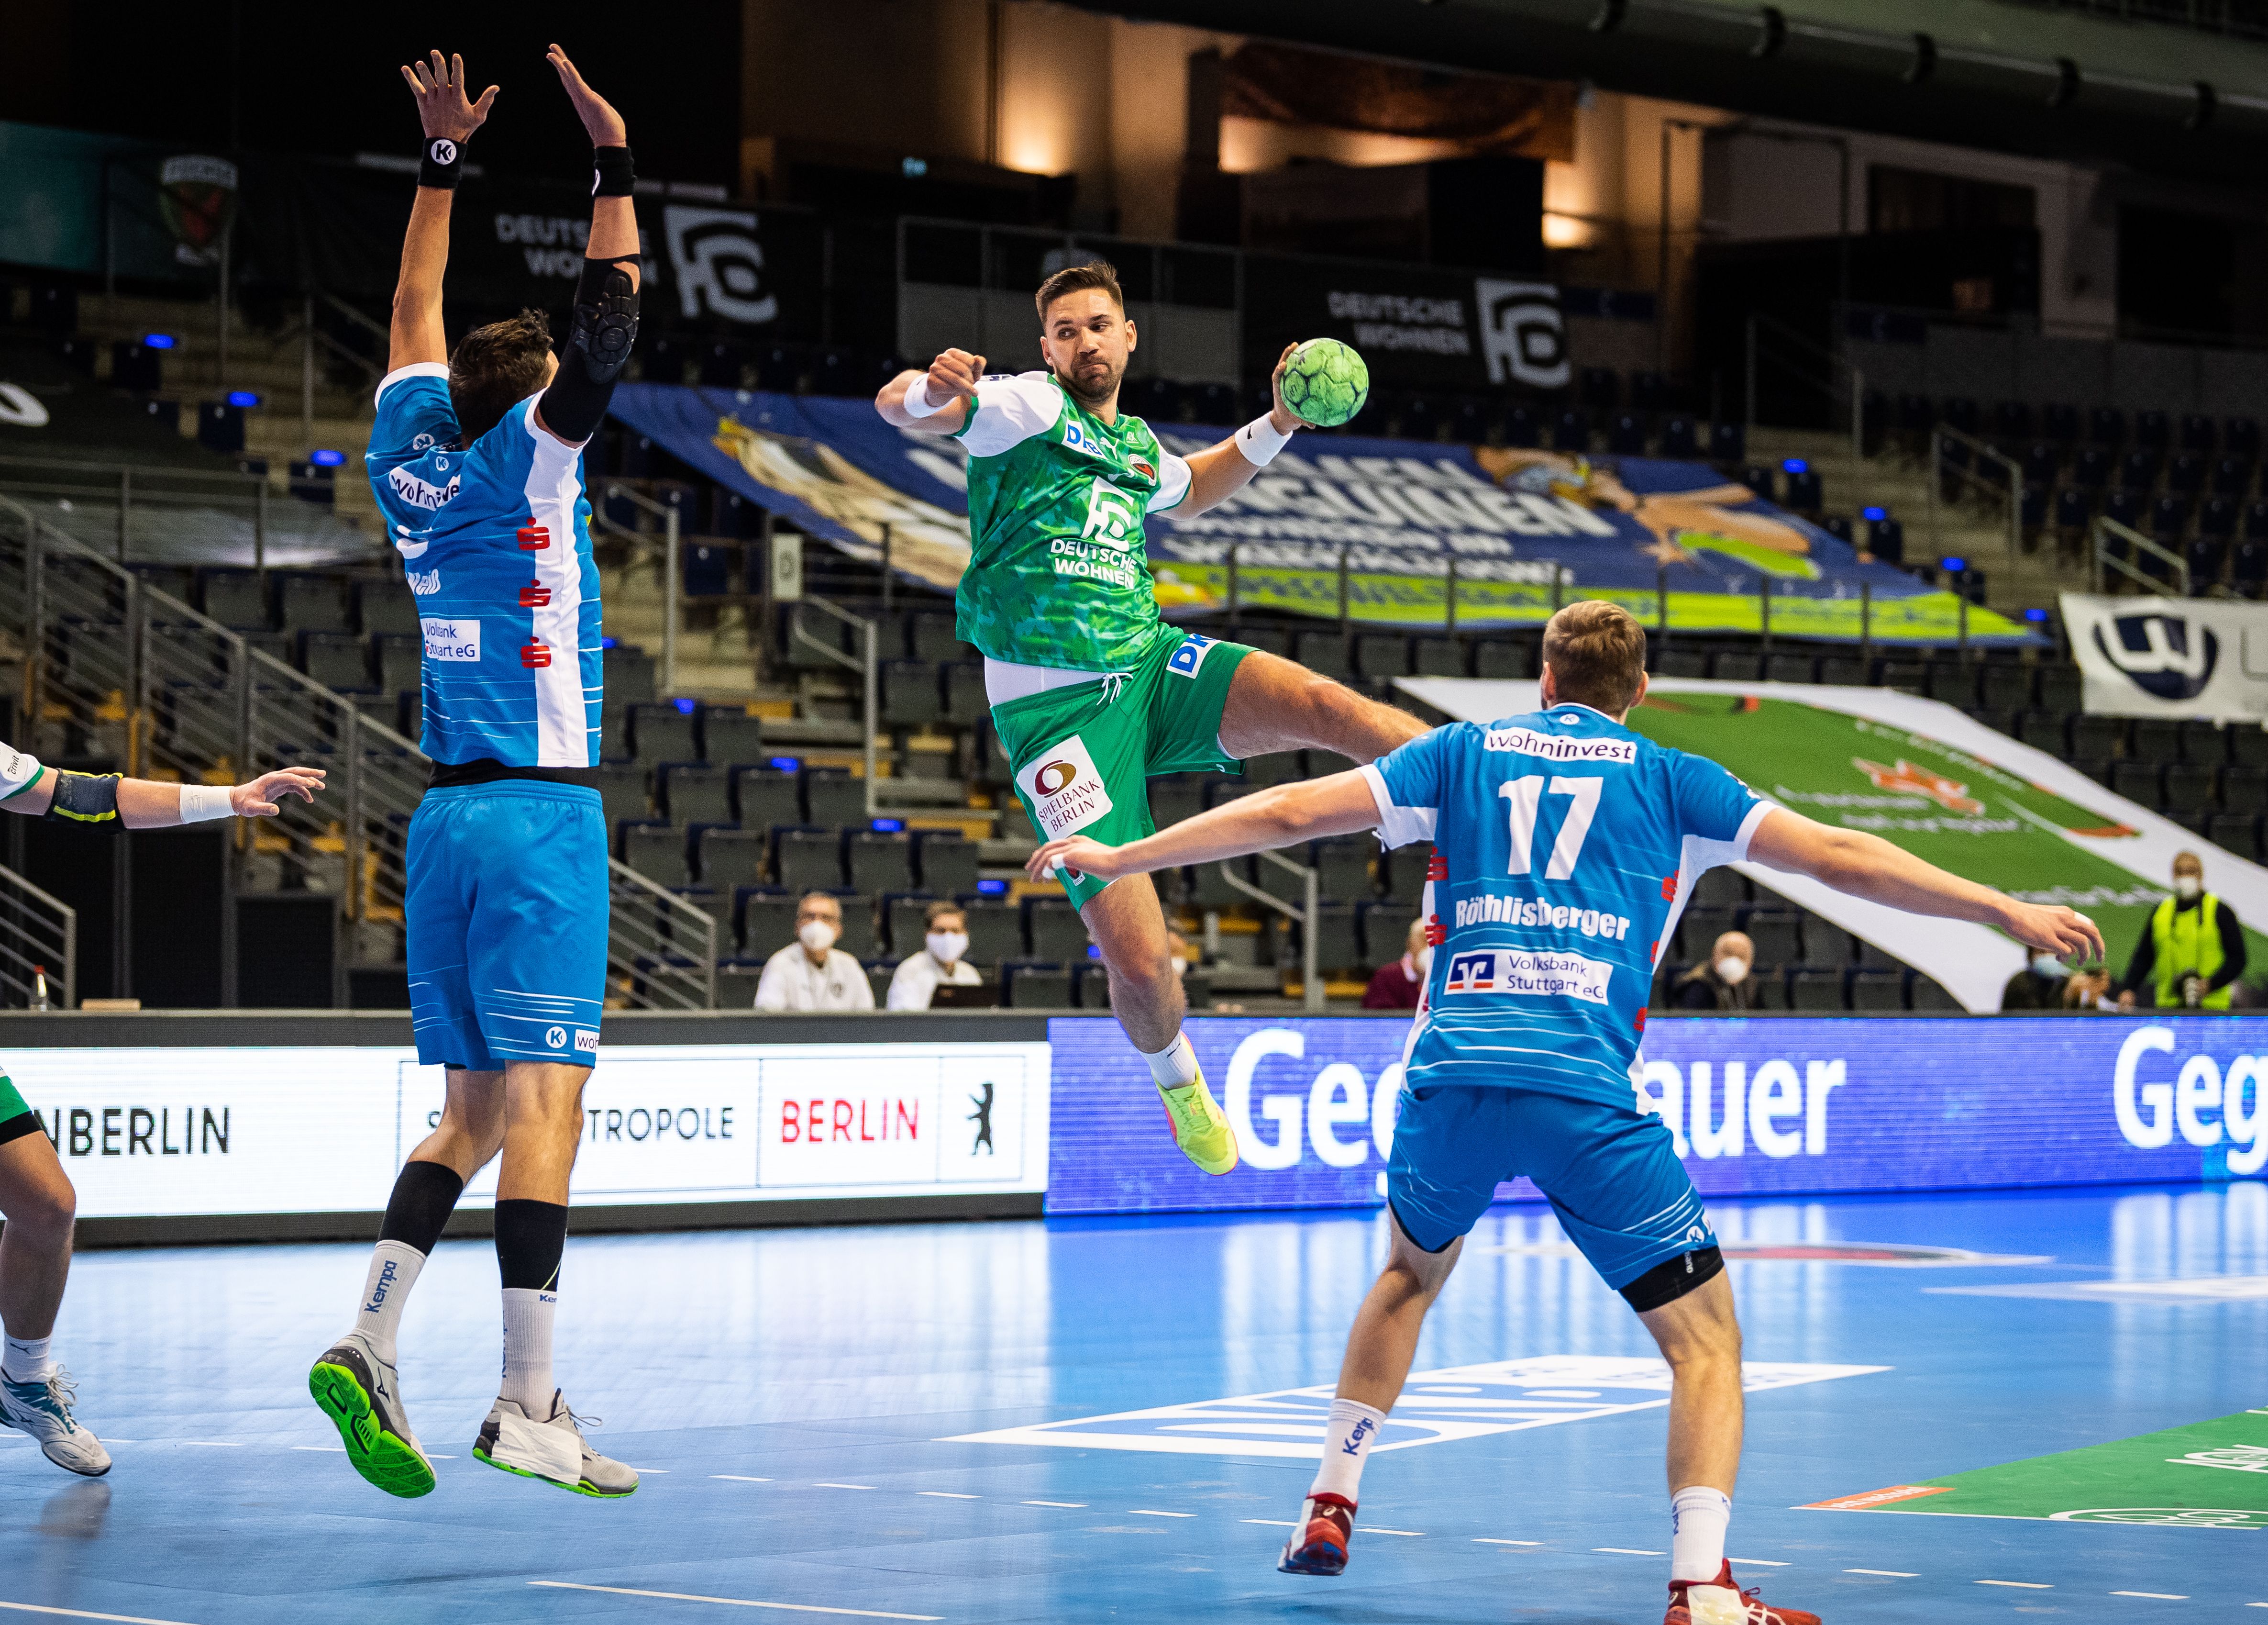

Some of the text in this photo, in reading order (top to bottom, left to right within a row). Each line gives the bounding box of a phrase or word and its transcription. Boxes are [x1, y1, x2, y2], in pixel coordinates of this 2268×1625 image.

[1327, 291, 1465, 326] DEUTSCHE
[1354, 322, 1470, 355] WOHNEN
[1051, 539, 1137, 575] DEUTSCHE
[1055, 558, 1134, 590] WOHNEN
[456, 644, 475, 657] eG
[1490, 733, 1632, 759] wohninvest
[11, 755, 19, 775] crivit
[1039, 778, 1100, 823] SPIELBANK
[1051, 797, 1095, 832] BERLIN
[1498, 775, 1604, 879] 17
[1456, 894, 1630, 941] Röthlisberger
[1509, 955, 1587, 977] Volksbank
[1507, 975, 1604, 999] Stuttgart eG
[781, 1099, 919, 1143] BERLIN
[364, 1260, 398, 1313] Kempa
